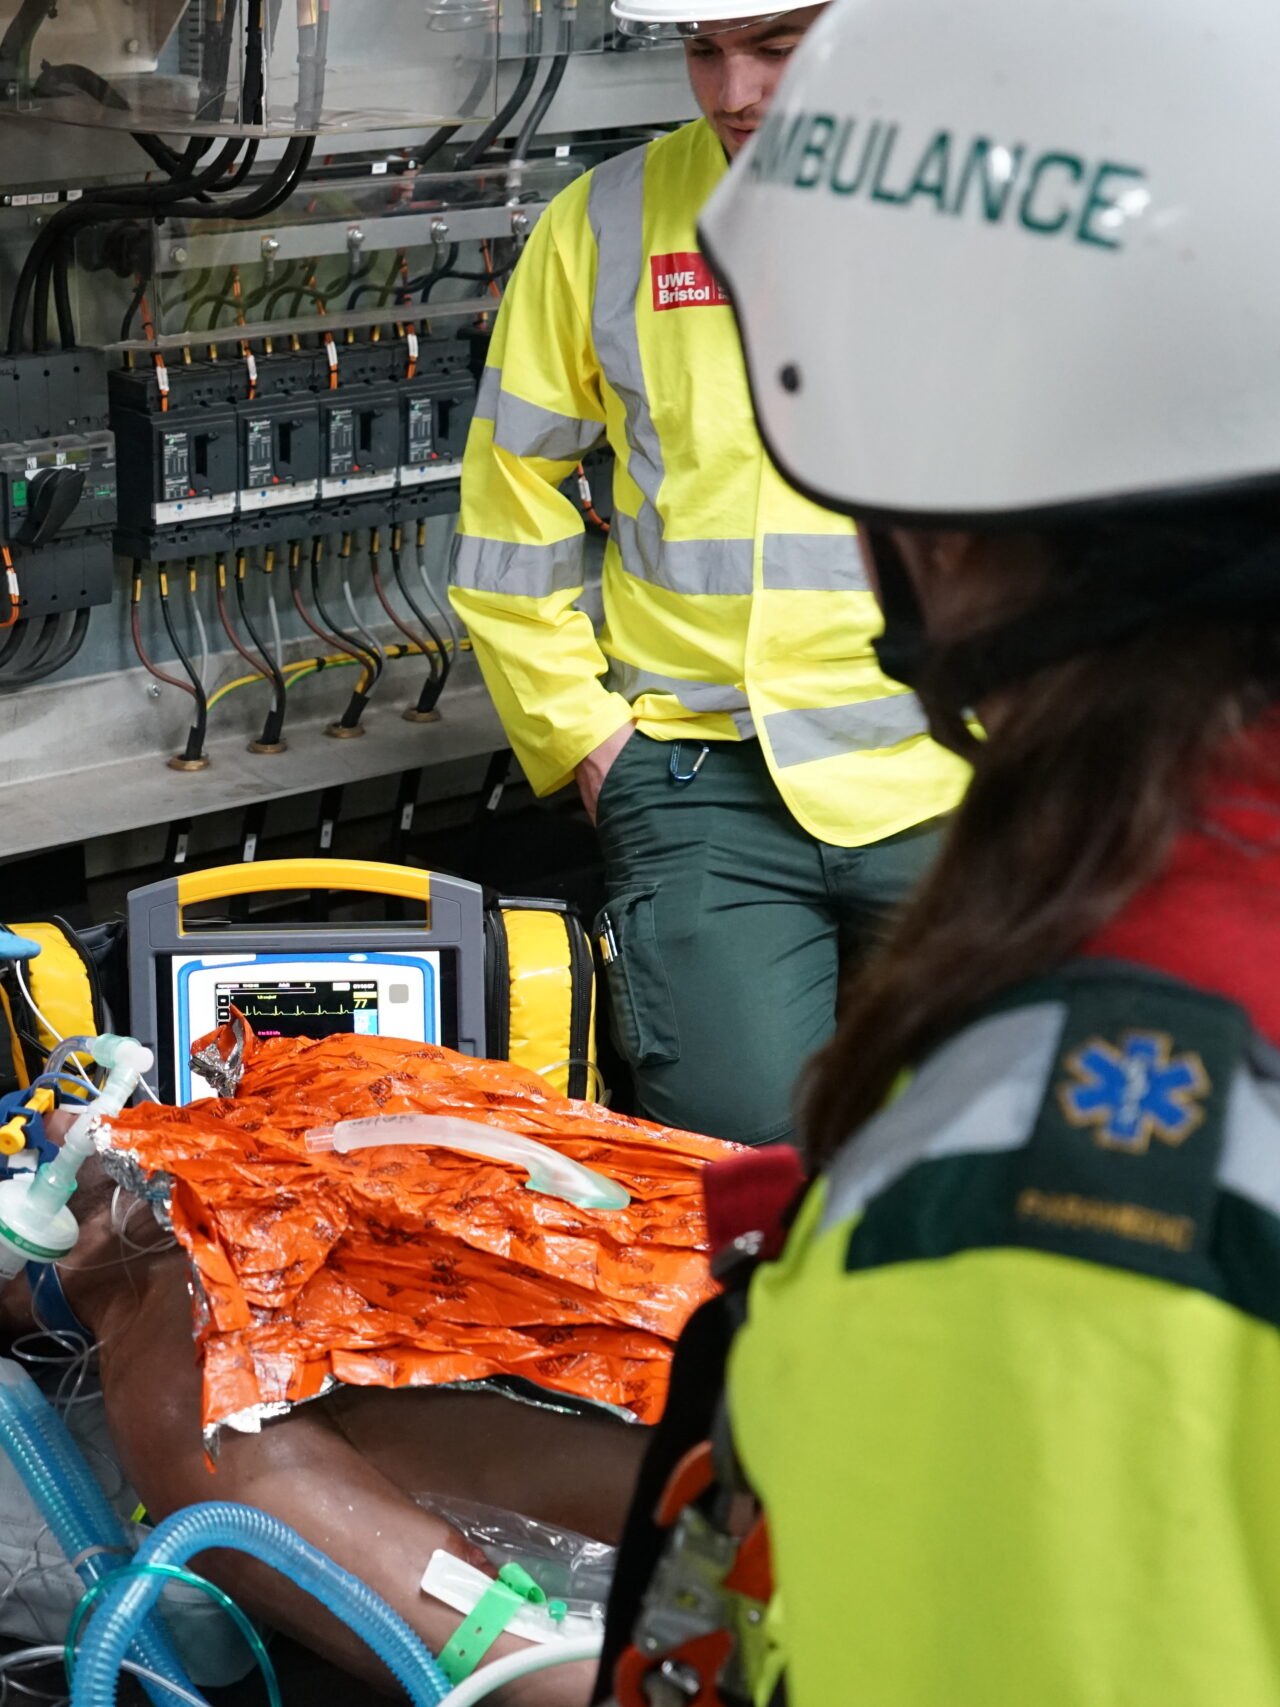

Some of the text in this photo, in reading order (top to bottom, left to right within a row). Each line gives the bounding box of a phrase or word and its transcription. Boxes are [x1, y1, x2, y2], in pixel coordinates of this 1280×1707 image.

[657, 271, 695, 289] UWE
[659, 286, 710, 305] Bristol
[353, 999, 368, 1009] 77
